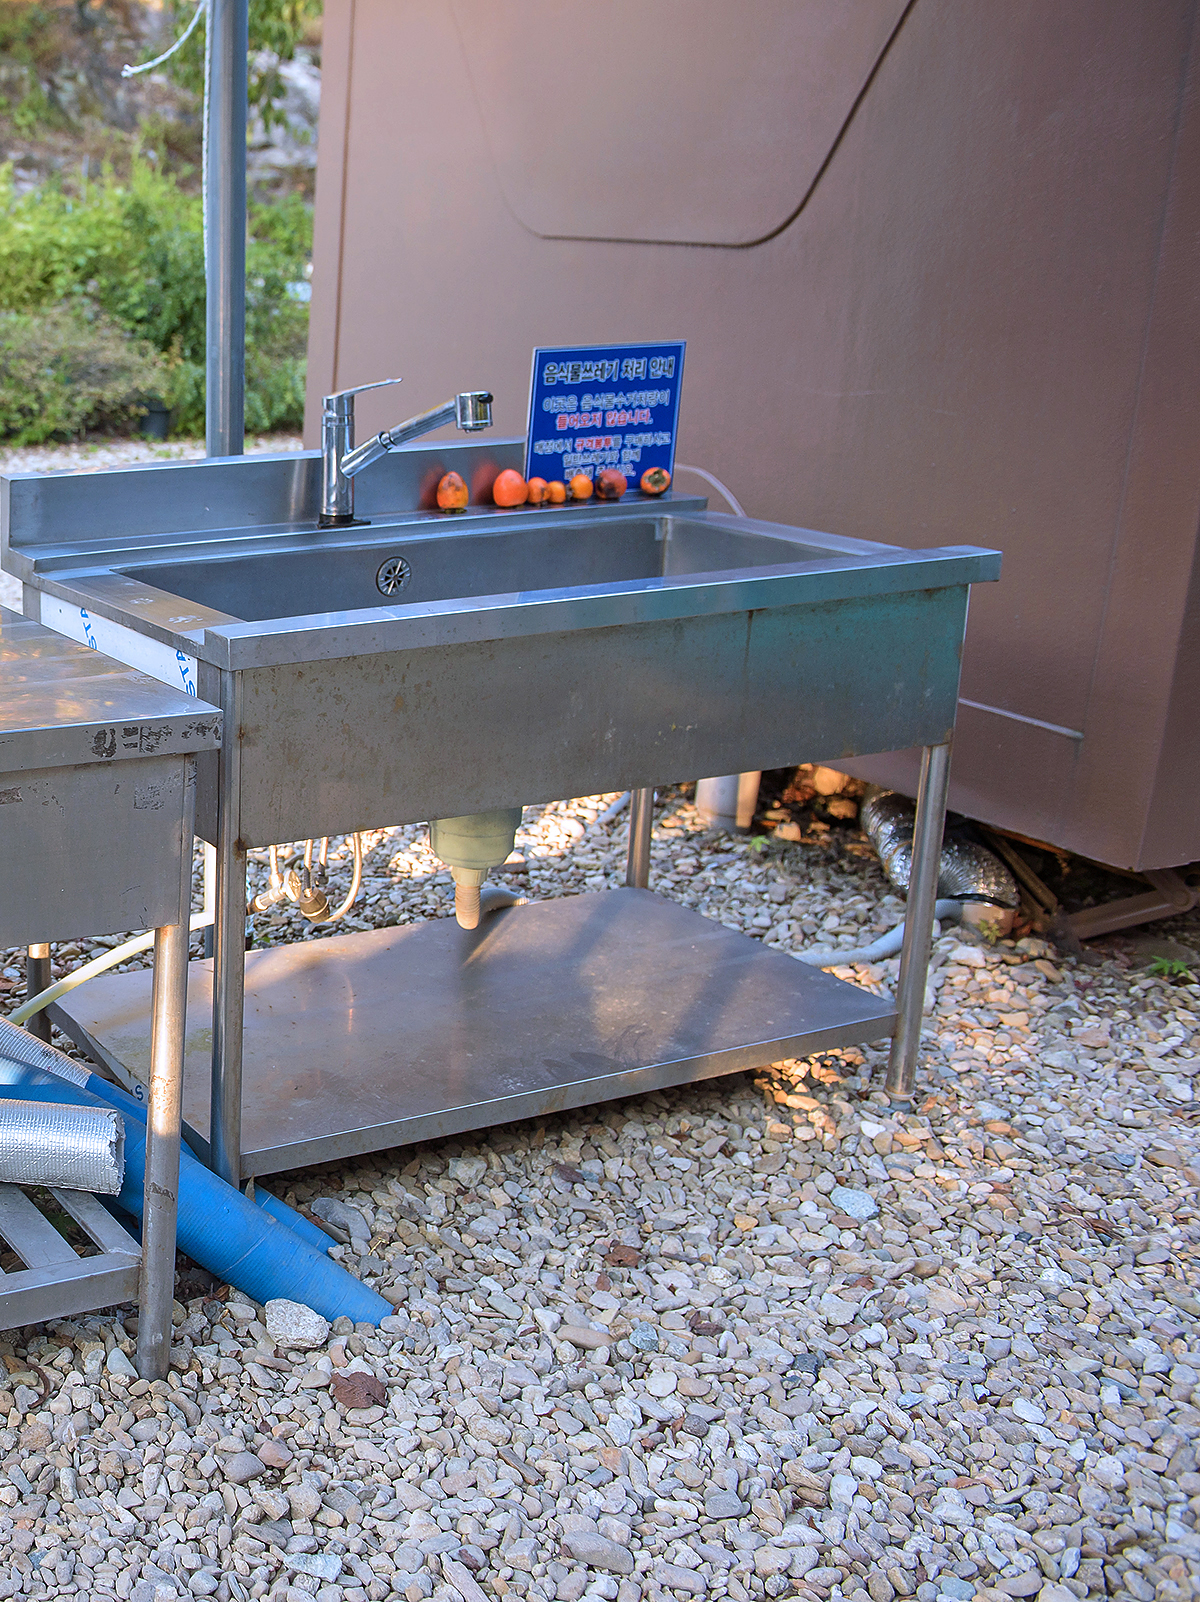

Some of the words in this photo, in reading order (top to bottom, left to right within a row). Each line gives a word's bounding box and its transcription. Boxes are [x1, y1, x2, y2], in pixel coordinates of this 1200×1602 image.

[543, 359, 619, 385] 음식물쓰레기
[621, 357, 647, 381] 처리
[650, 355, 675, 378] 안내
[542, 394, 578, 413] 이곳은
[556, 411, 602, 430] 들어오지
